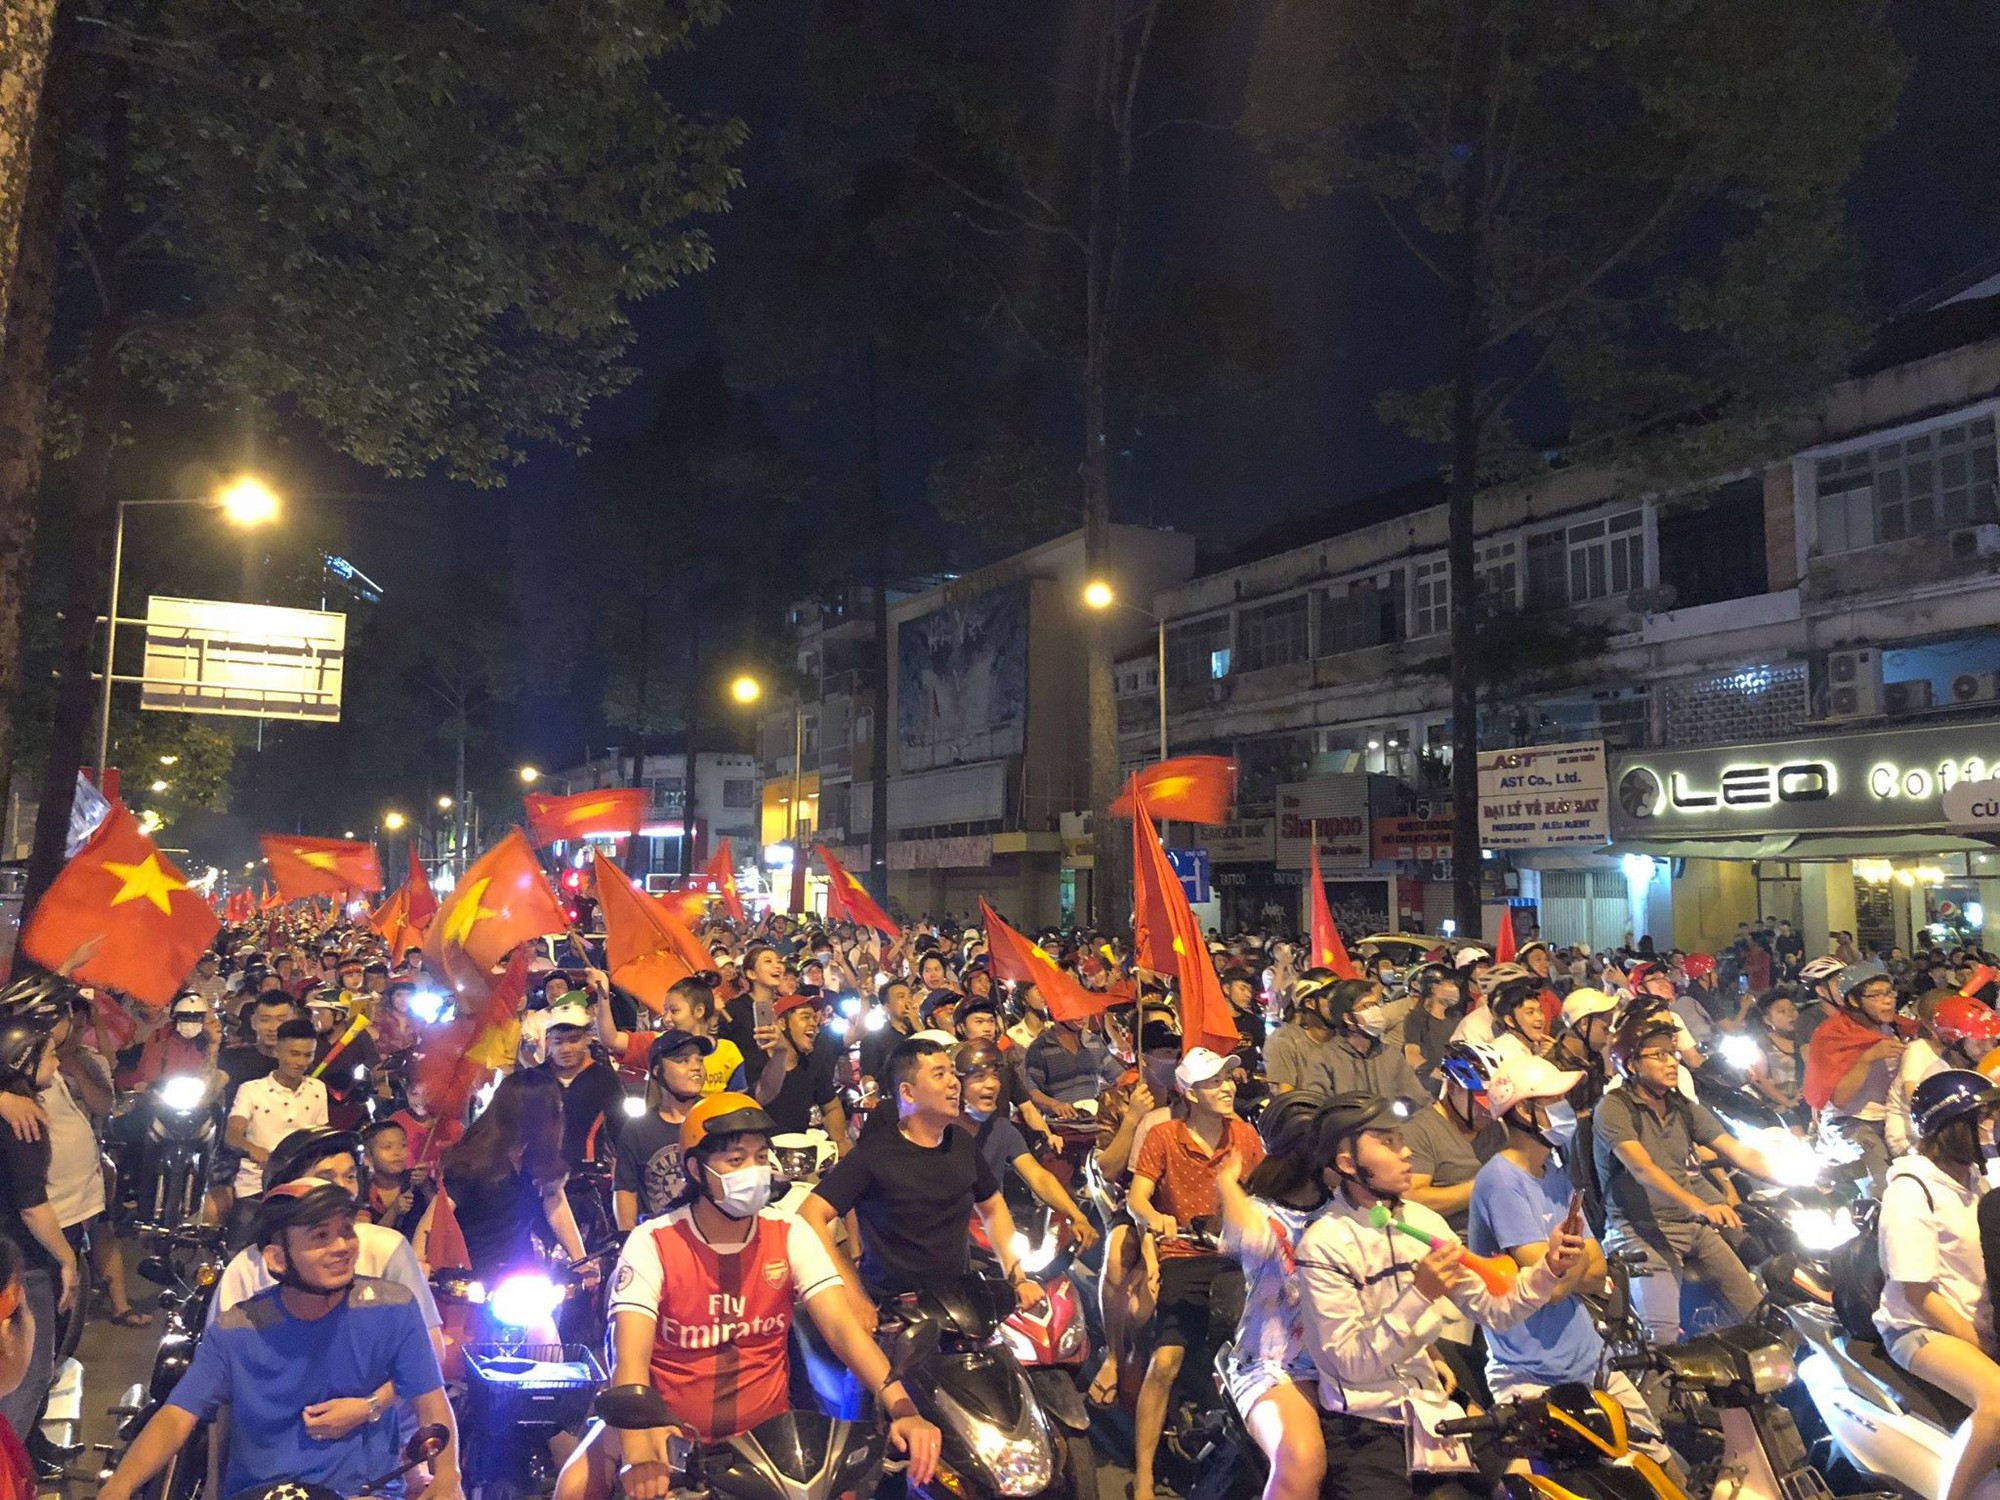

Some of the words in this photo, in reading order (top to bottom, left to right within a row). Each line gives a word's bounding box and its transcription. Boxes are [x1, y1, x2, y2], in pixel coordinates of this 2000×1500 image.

[1494, 753, 1536, 769] AST
[1500, 776, 1524, 788] AST
[1527, 775, 1552, 787] Co.,
[1556, 771, 1581, 784] Ltd.
[1671, 763, 1831, 808] LEO
[1871, 759, 2000, 799] Coff
[708, 1293, 746, 1317] Fly
[661, 1312, 786, 1349] Emirates
